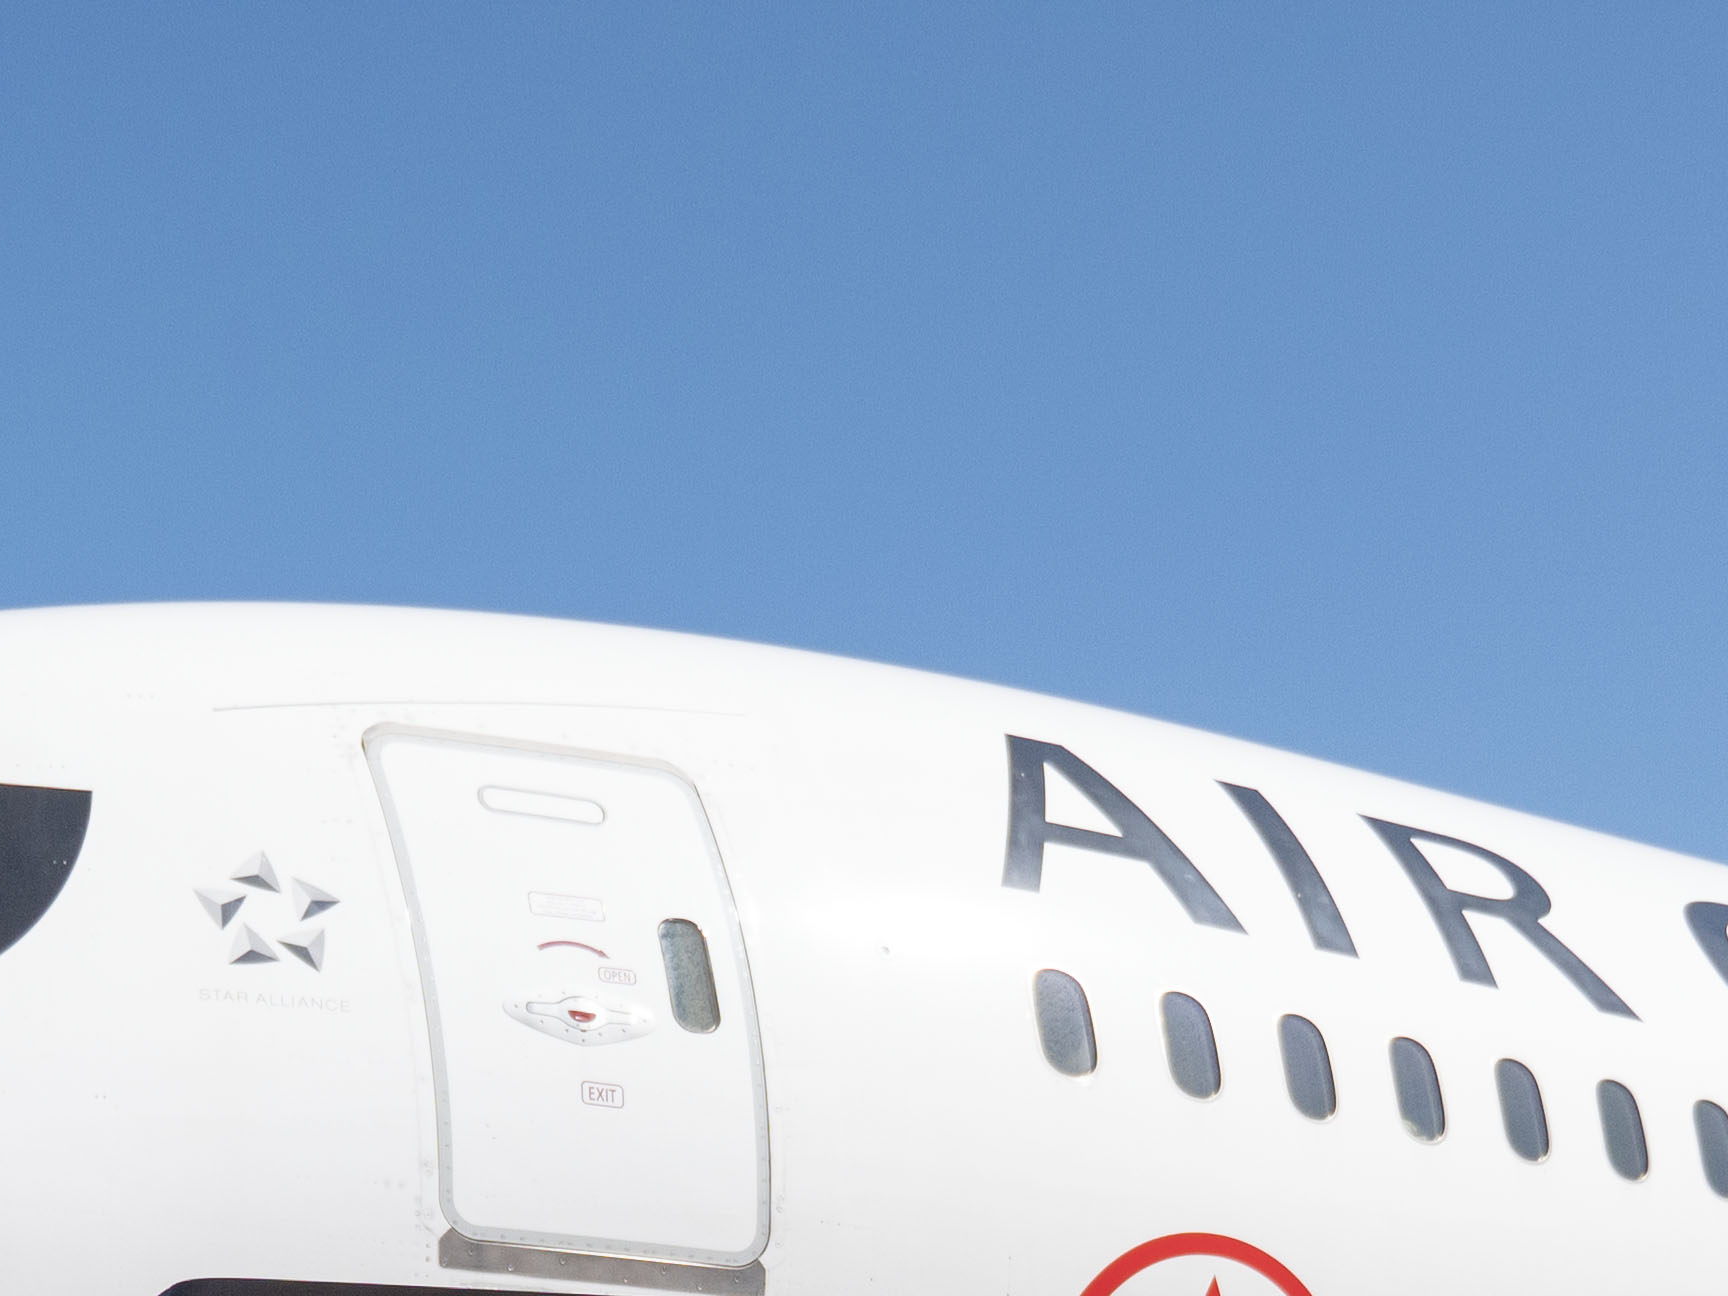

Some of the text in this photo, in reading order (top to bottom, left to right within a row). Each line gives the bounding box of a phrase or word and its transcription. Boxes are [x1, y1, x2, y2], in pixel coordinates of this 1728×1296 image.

[1002, 733, 1643, 1022] AIR
[603, 969, 632, 983] OPEN
[198, 987, 353, 1014] STAR ALLIANCE
[587, 1086, 617, 1104] EXIT
